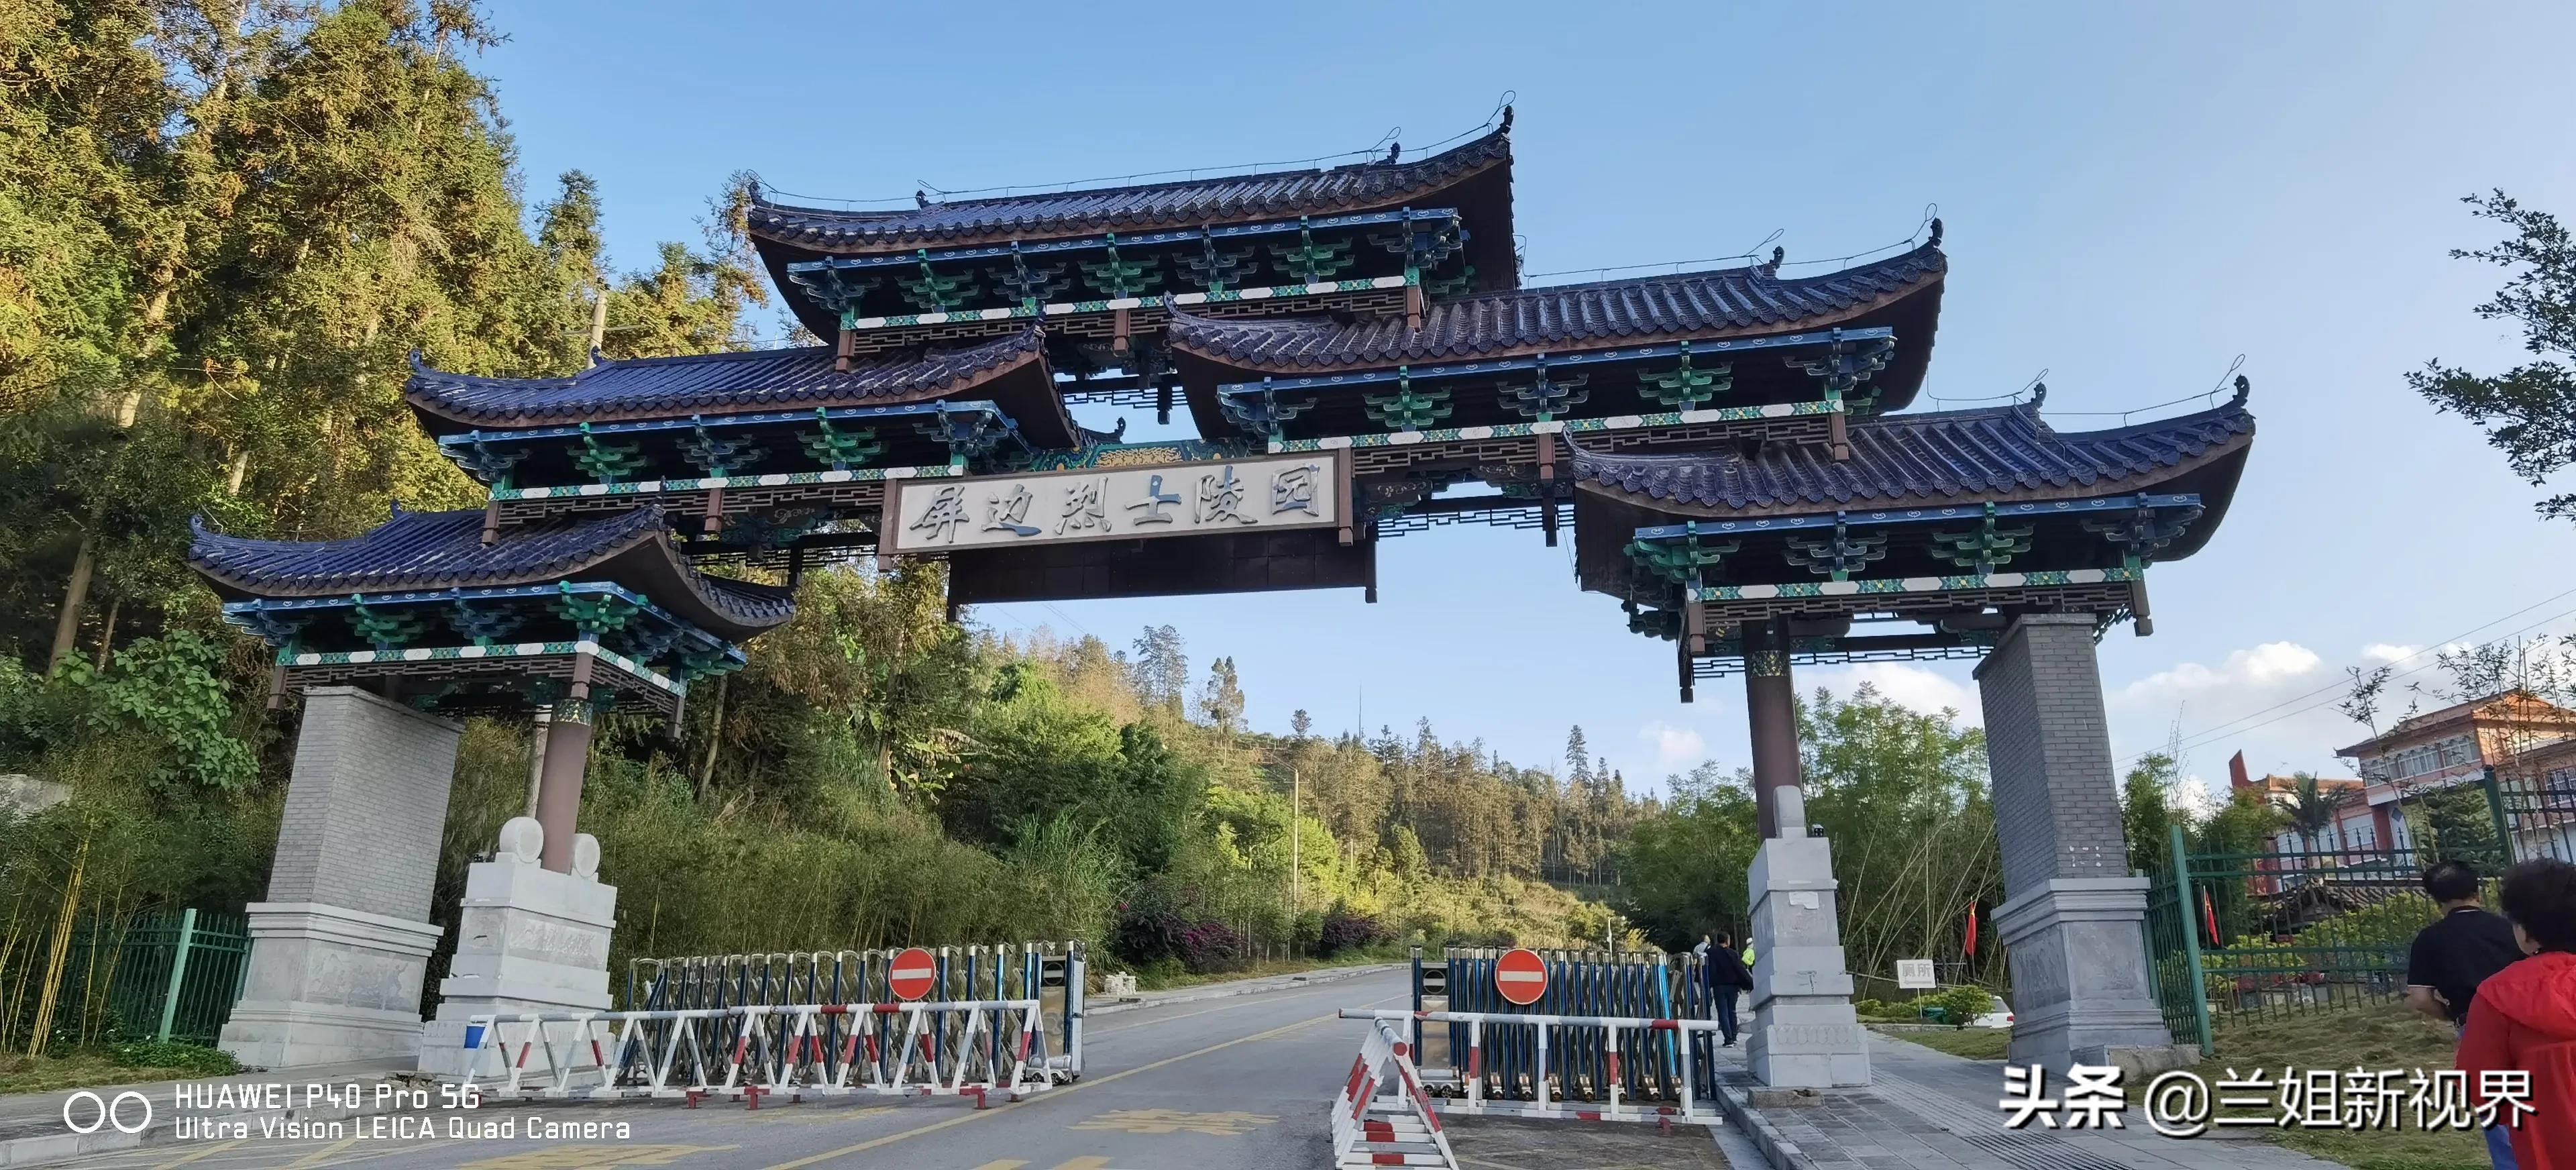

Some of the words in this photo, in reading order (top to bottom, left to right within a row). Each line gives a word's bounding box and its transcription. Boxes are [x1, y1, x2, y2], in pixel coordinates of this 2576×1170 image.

[908, 463, 1320, 543] 屏边烈士陵园
[1902, 963, 1931, 977] 厕所
